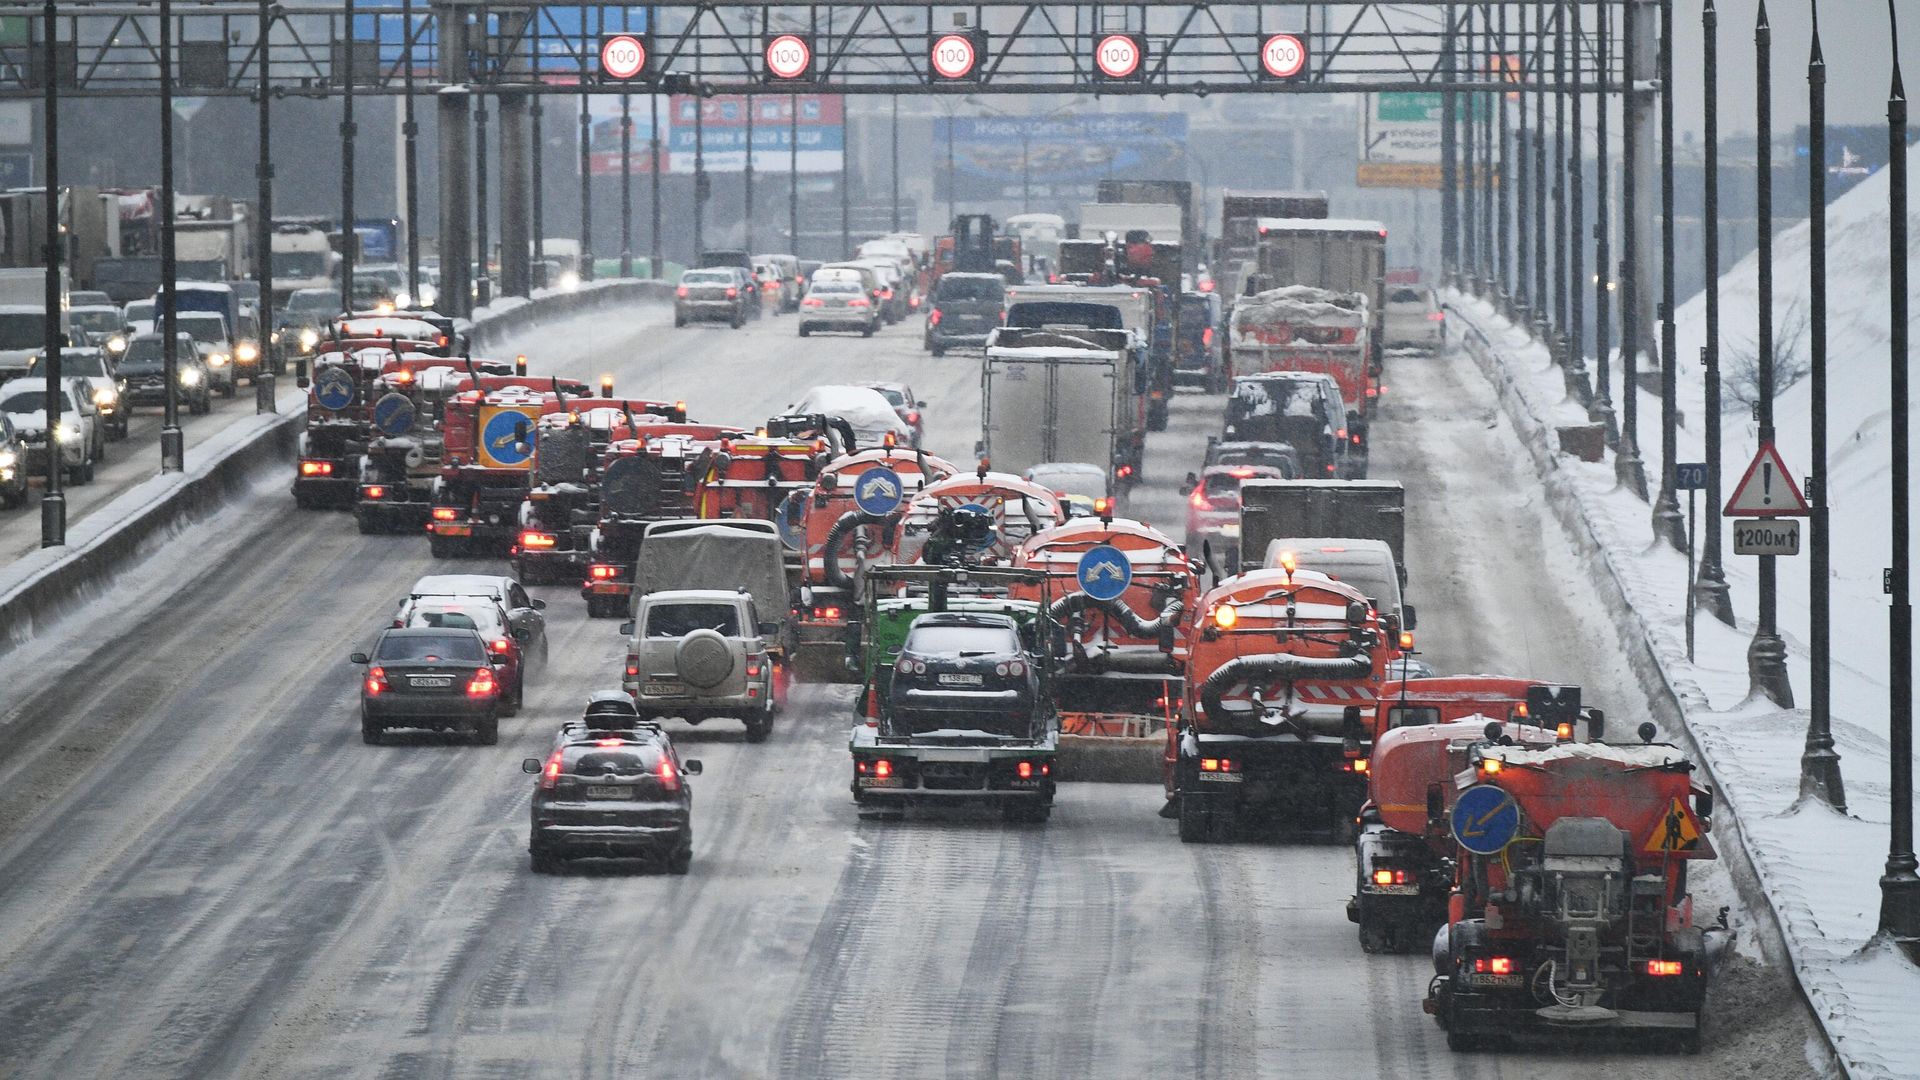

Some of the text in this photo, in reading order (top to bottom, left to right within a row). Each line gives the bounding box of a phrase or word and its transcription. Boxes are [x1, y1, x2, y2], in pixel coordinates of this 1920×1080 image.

[610, 48, 636, 63] 100
[774, 49, 800, 63] 100
[940, 49, 966, 62] 100
[1104, 49, 1130, 62] 100
[1271, 48, 1295, 61] 100
[1681, 468, 1701, 483] 70
